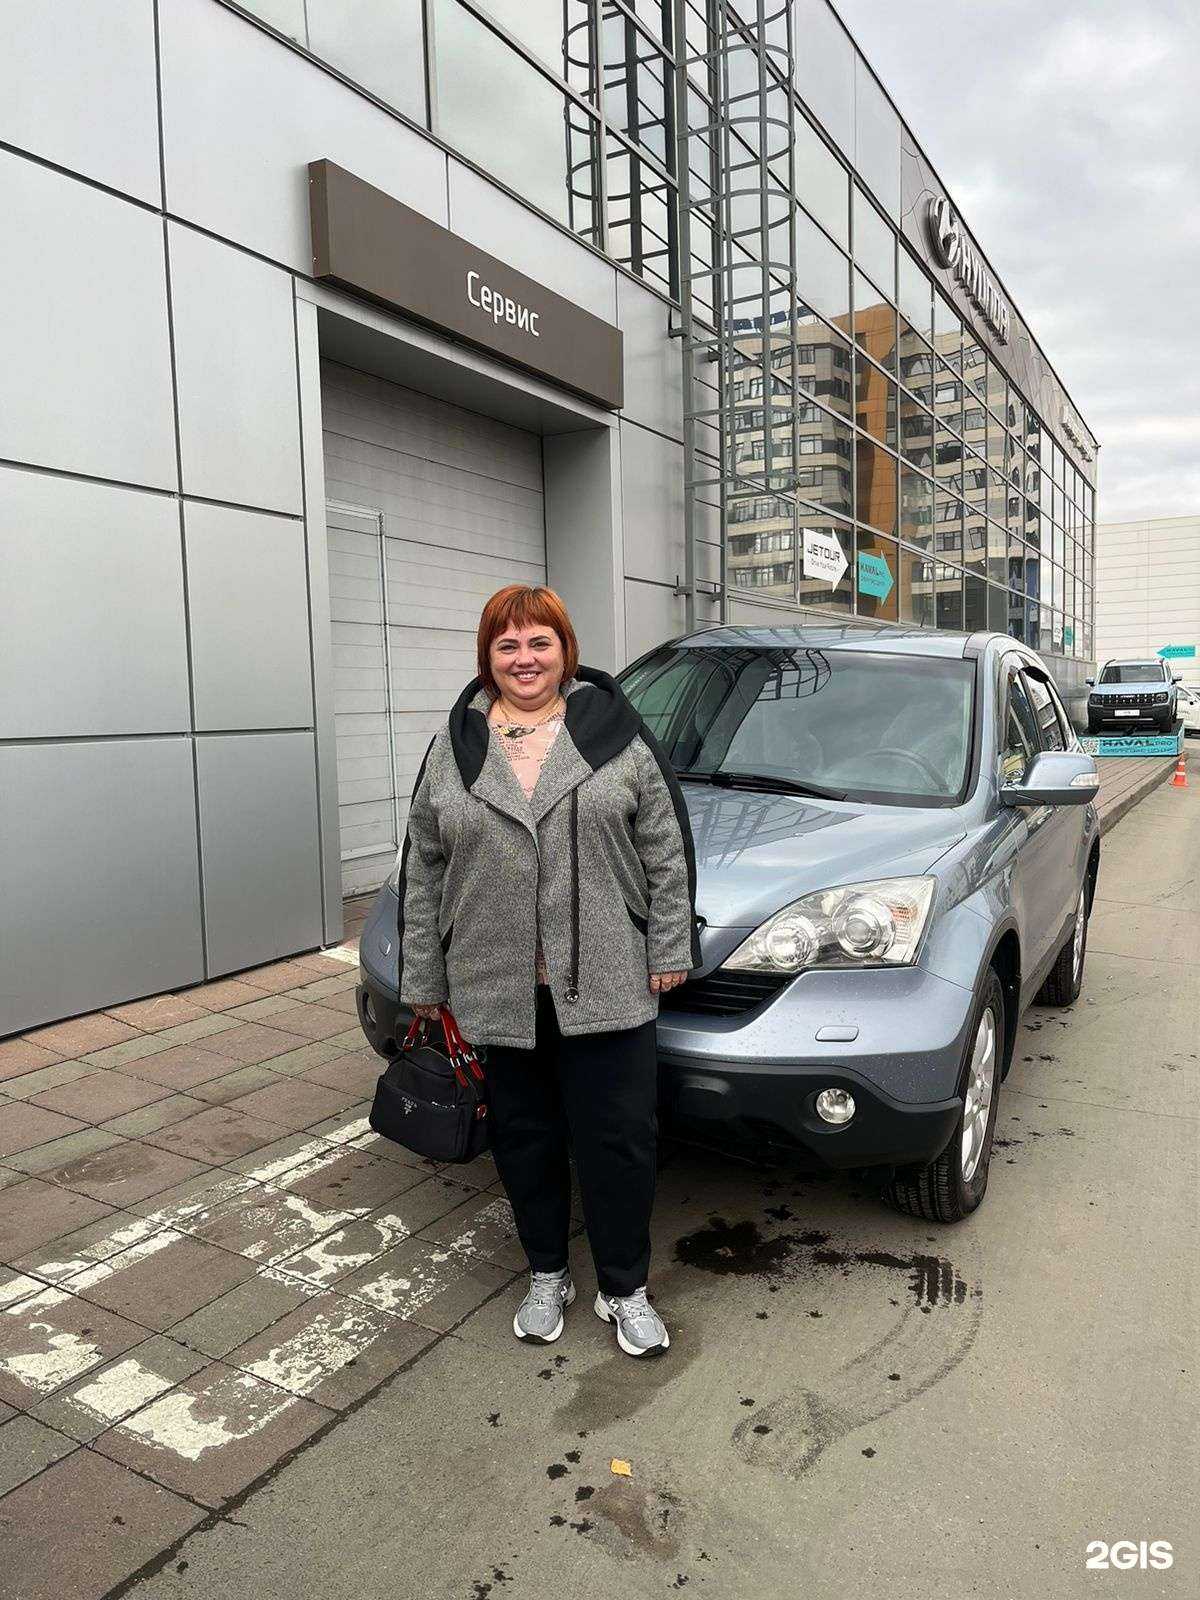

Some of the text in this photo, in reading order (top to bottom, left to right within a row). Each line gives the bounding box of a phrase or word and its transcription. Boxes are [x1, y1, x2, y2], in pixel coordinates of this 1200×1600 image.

[467, 271, 539, 336] Сервис
[807, 543, 840, 562] JETOUR
[1102, 739, 1154, 747] HAVAL
